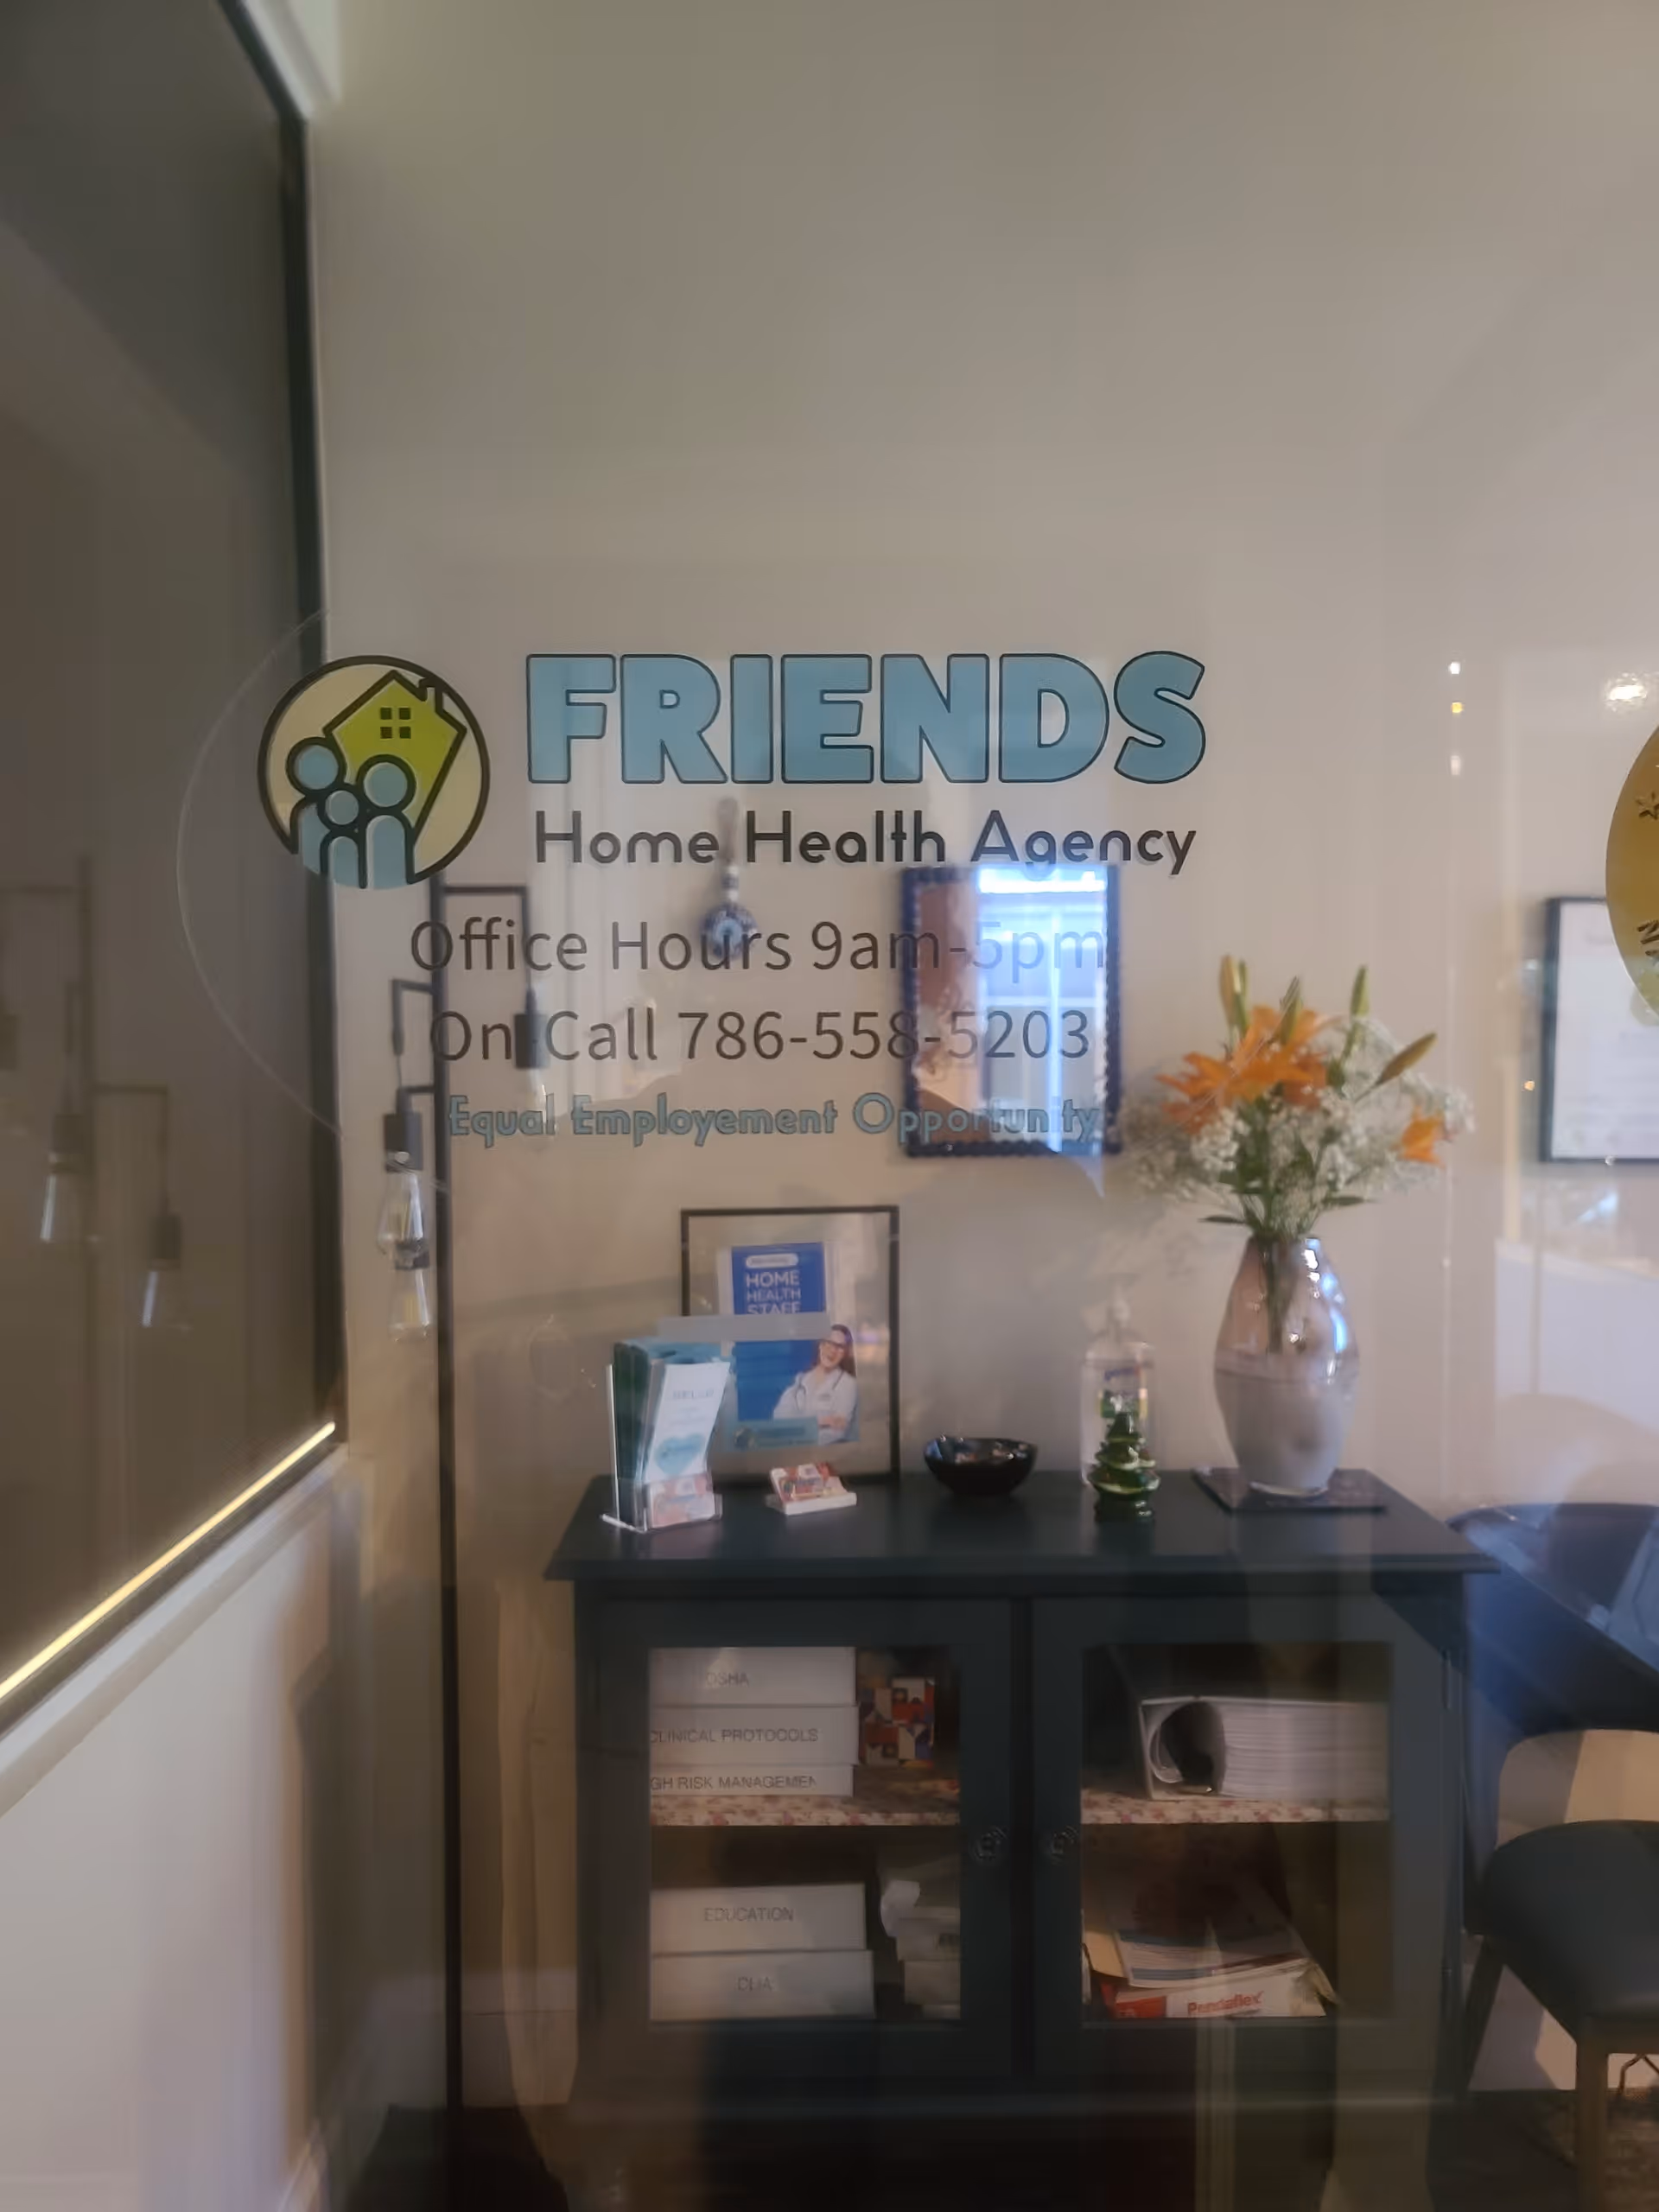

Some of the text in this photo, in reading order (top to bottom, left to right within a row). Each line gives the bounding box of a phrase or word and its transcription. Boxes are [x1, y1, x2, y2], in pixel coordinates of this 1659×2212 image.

[526, 652, 1206, 785] FRIENDS
[536, 810, 1197, 875] Home Health Agency
[410, 916, 1105, 983] Office Hours 9am-5pm
[433, 1007, 1090, 1061] On Call 786-558-5203
[449, 1092, 556, 1148] Equal
[571, 1091, 838, 1147] Employement
[746, 1270, 800, 1288] HOME
[747, 1287, 801, 1303] HEALTH
[650, 1727, 819, 1744] CLINICAL PROTOCOLS
[677, 1777, 713, 1790] RISK
